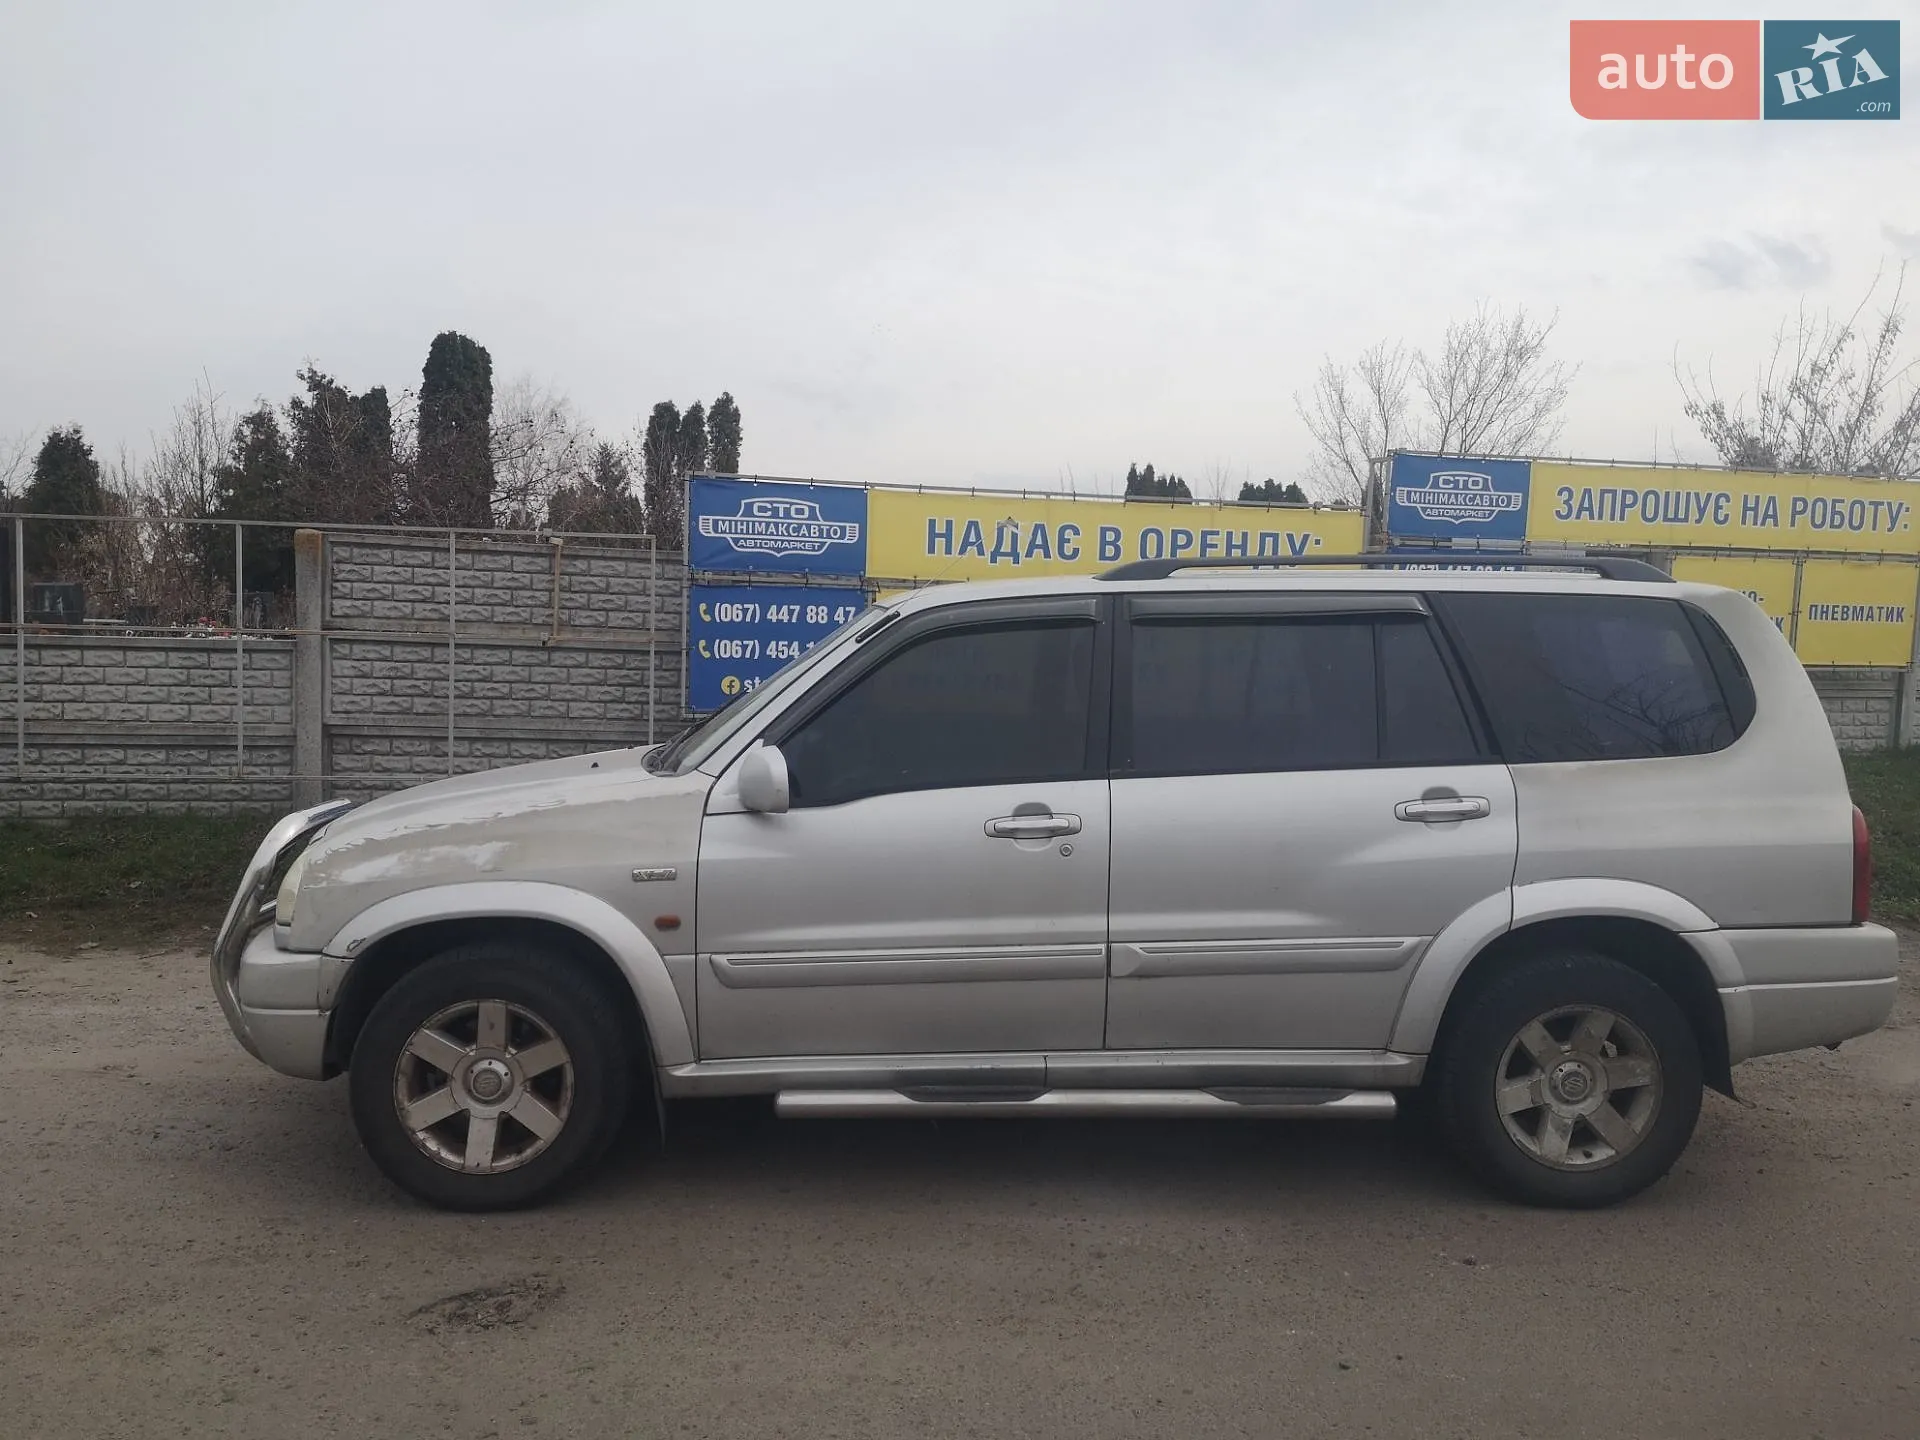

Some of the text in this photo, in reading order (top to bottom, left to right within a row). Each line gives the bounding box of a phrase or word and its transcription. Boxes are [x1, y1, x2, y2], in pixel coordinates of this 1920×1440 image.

[1438, 475, 1484, 490] СТО
[1410, 491, 1508, 507] МІНІМАКСАВТО
[752, 502, 809, 519] СТО
[1425, 508, 1491, 518] АВТОМАРКЕТ
[1555, 486, 1912, 533] ЗАПРОШУЄ НА РОБОТУ:
[717, 520, 841, 539] МІНІМАКСАВТО
[737, 538, 821, 551] АВТОМАРКЕТ
[926, 517, 1081, 565] НАДАЄ
[1099, 525, 1122, 562] В
[714, 602, 857, 625] (067) 447 88 47
[1808, 603, 1905, 623] ПНЕВМАТИК
[713, 639, 801, 660] (067) 454
